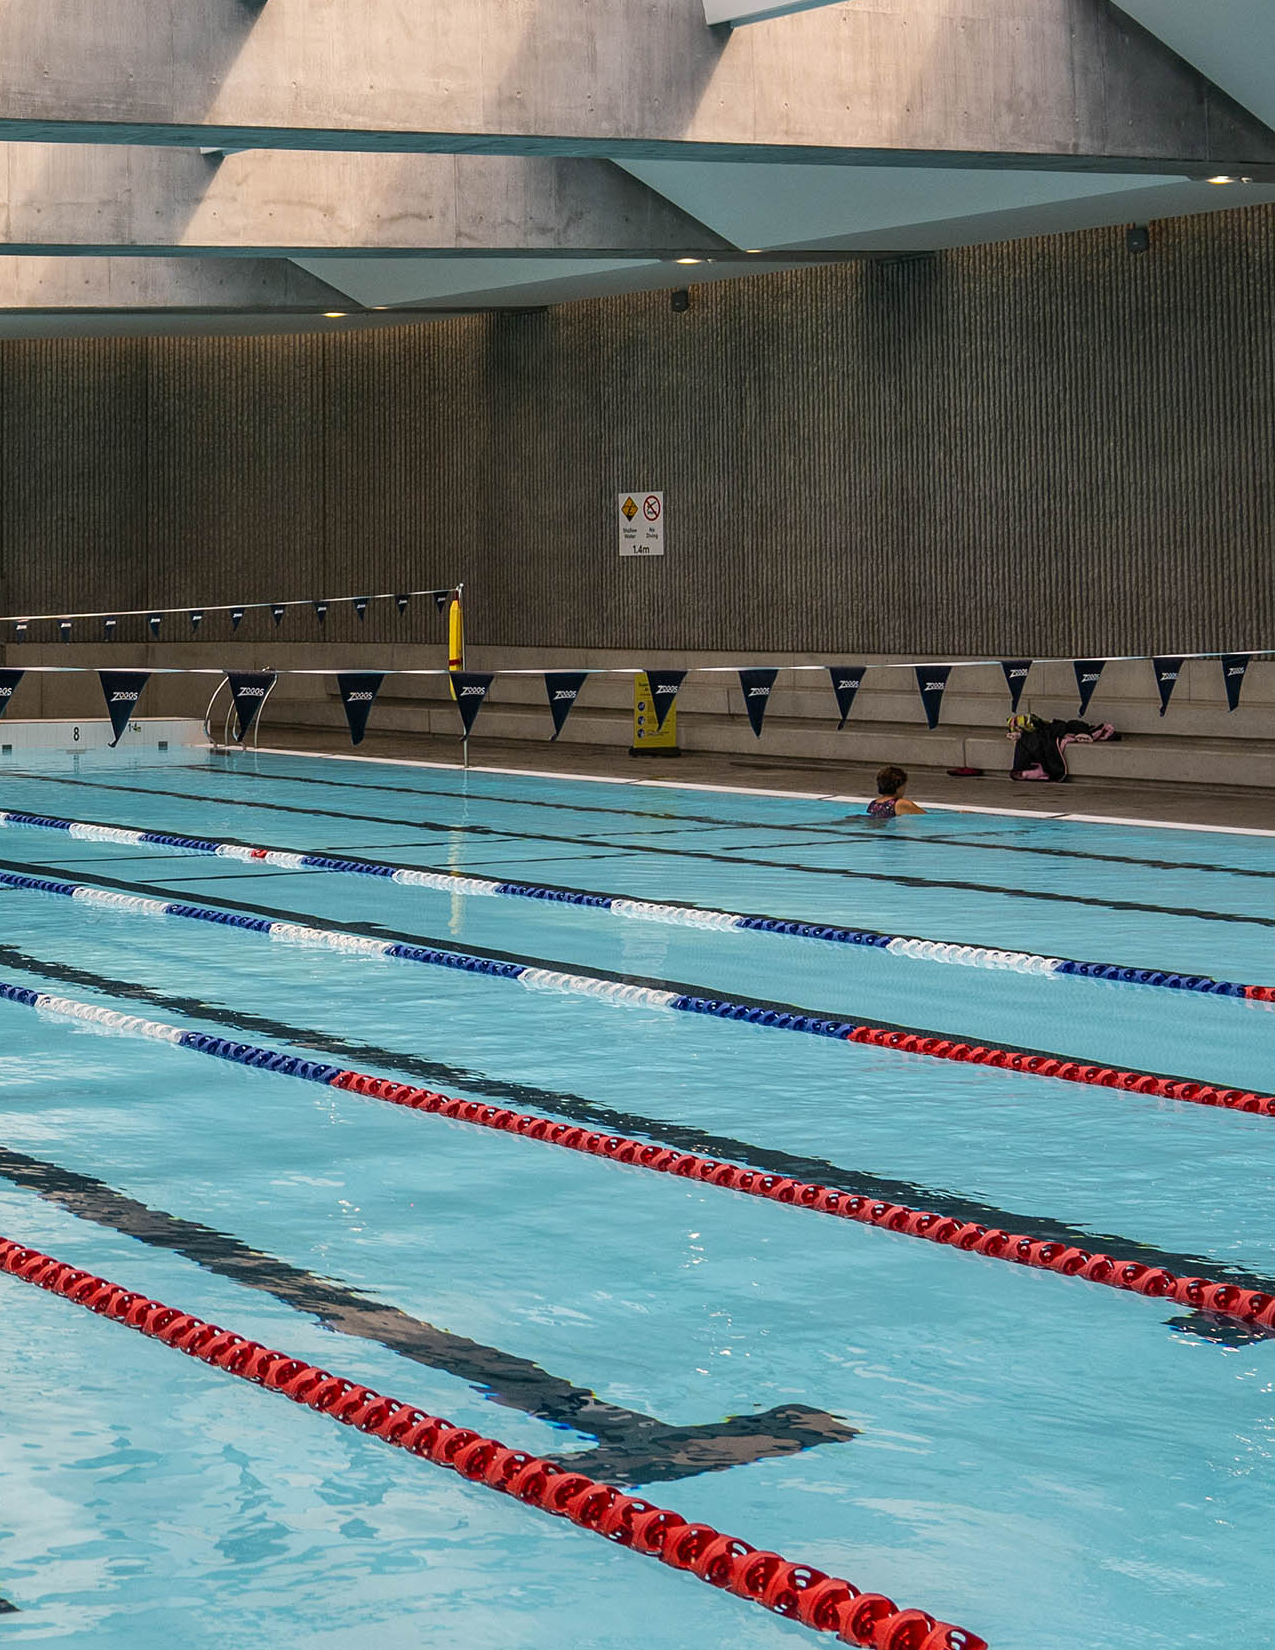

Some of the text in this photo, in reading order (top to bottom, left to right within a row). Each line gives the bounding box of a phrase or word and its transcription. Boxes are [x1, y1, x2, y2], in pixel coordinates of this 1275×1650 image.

[633, 545, 650, 553] 1.4m
[110, 691, 138, 701] ZOGGS
[237, 687, 265, 697] ZOGGS
[347, 692, 373, 701] ZOGGS
[73, 726, 79, 741] 8
